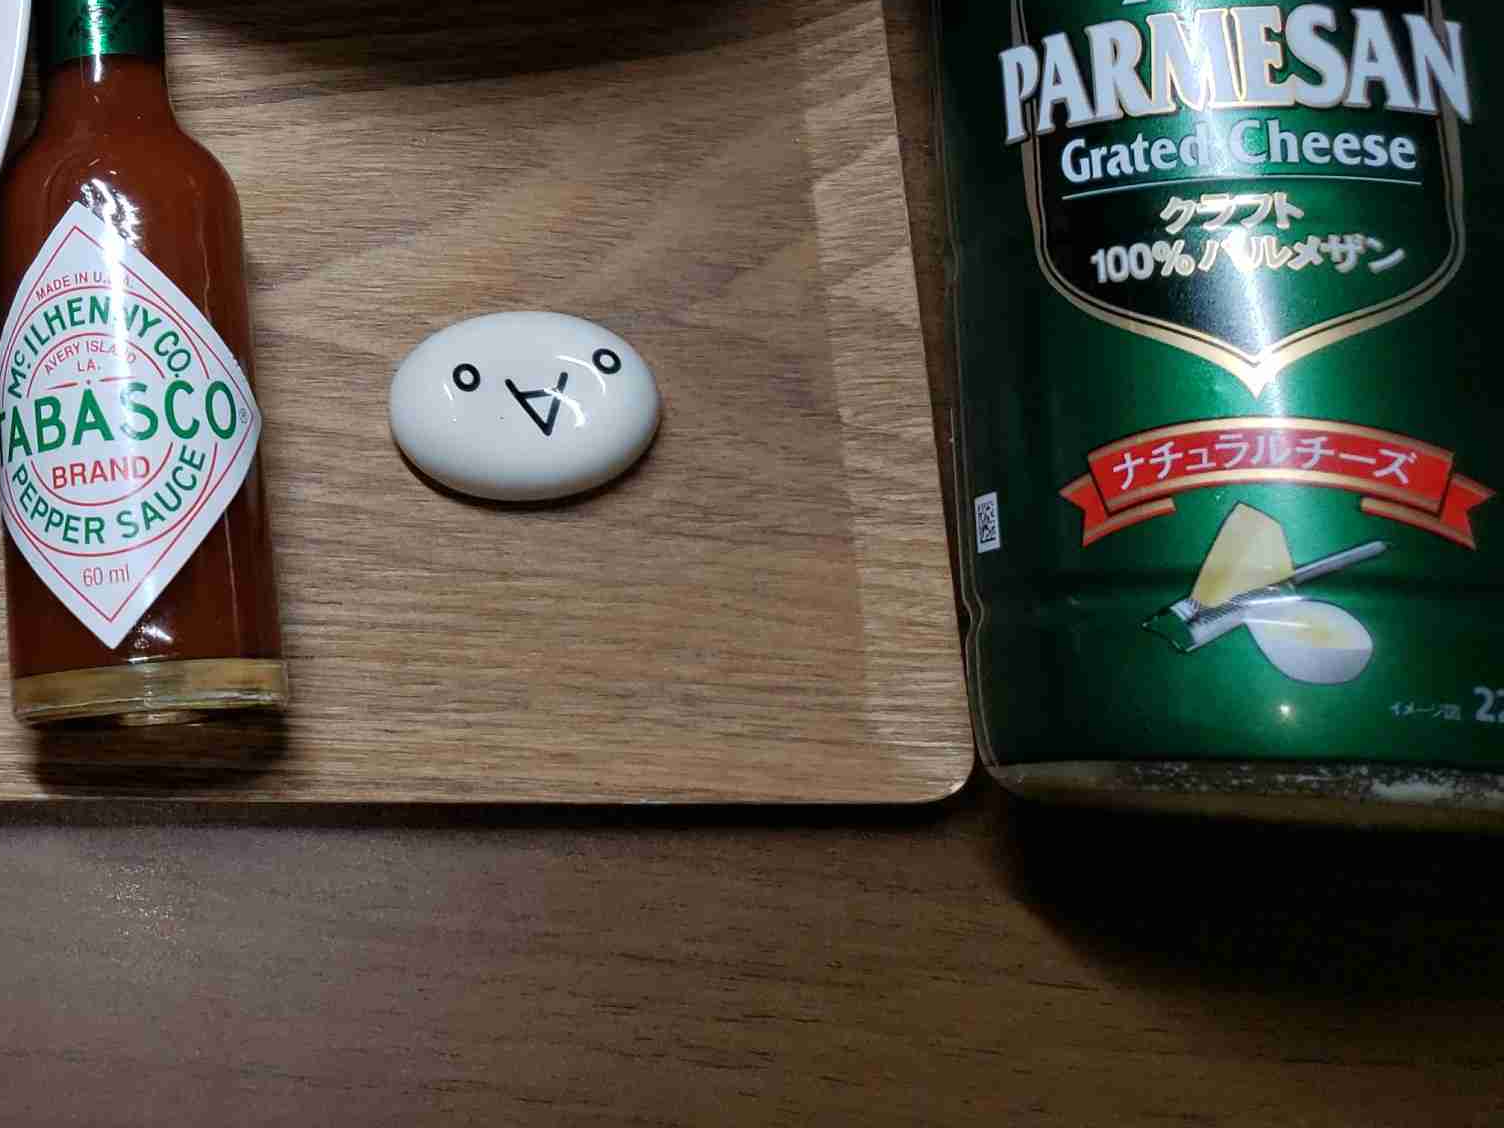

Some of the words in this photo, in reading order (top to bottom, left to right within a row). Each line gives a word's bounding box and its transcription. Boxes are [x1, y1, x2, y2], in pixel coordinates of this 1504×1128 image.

[998, 4, 1473, 147] PARMESAN
[1061, 122, 1212, 185] Grated
[1229, 119, 1418, 171] Cheese
[1159, 191, 1304, 235] クラフト
[36, 275, 73, 302] MADE
[75, 271, 89, 284] IN
[43, 341, 82, 375] AVERY
[86, 339, 137, 365] ISLAD
[77, 359, 102, 373] LA.
[154, 331, 192, 378] CO.
[52, 455, 151, 490] BRAND
[1112, 432, 1419, 491] ナチュラルチーズ
[12, 464, 105, 545] PEPPER
[116, 444, 206, 539] SAUCE
[82, 566, 104, 587] 60
